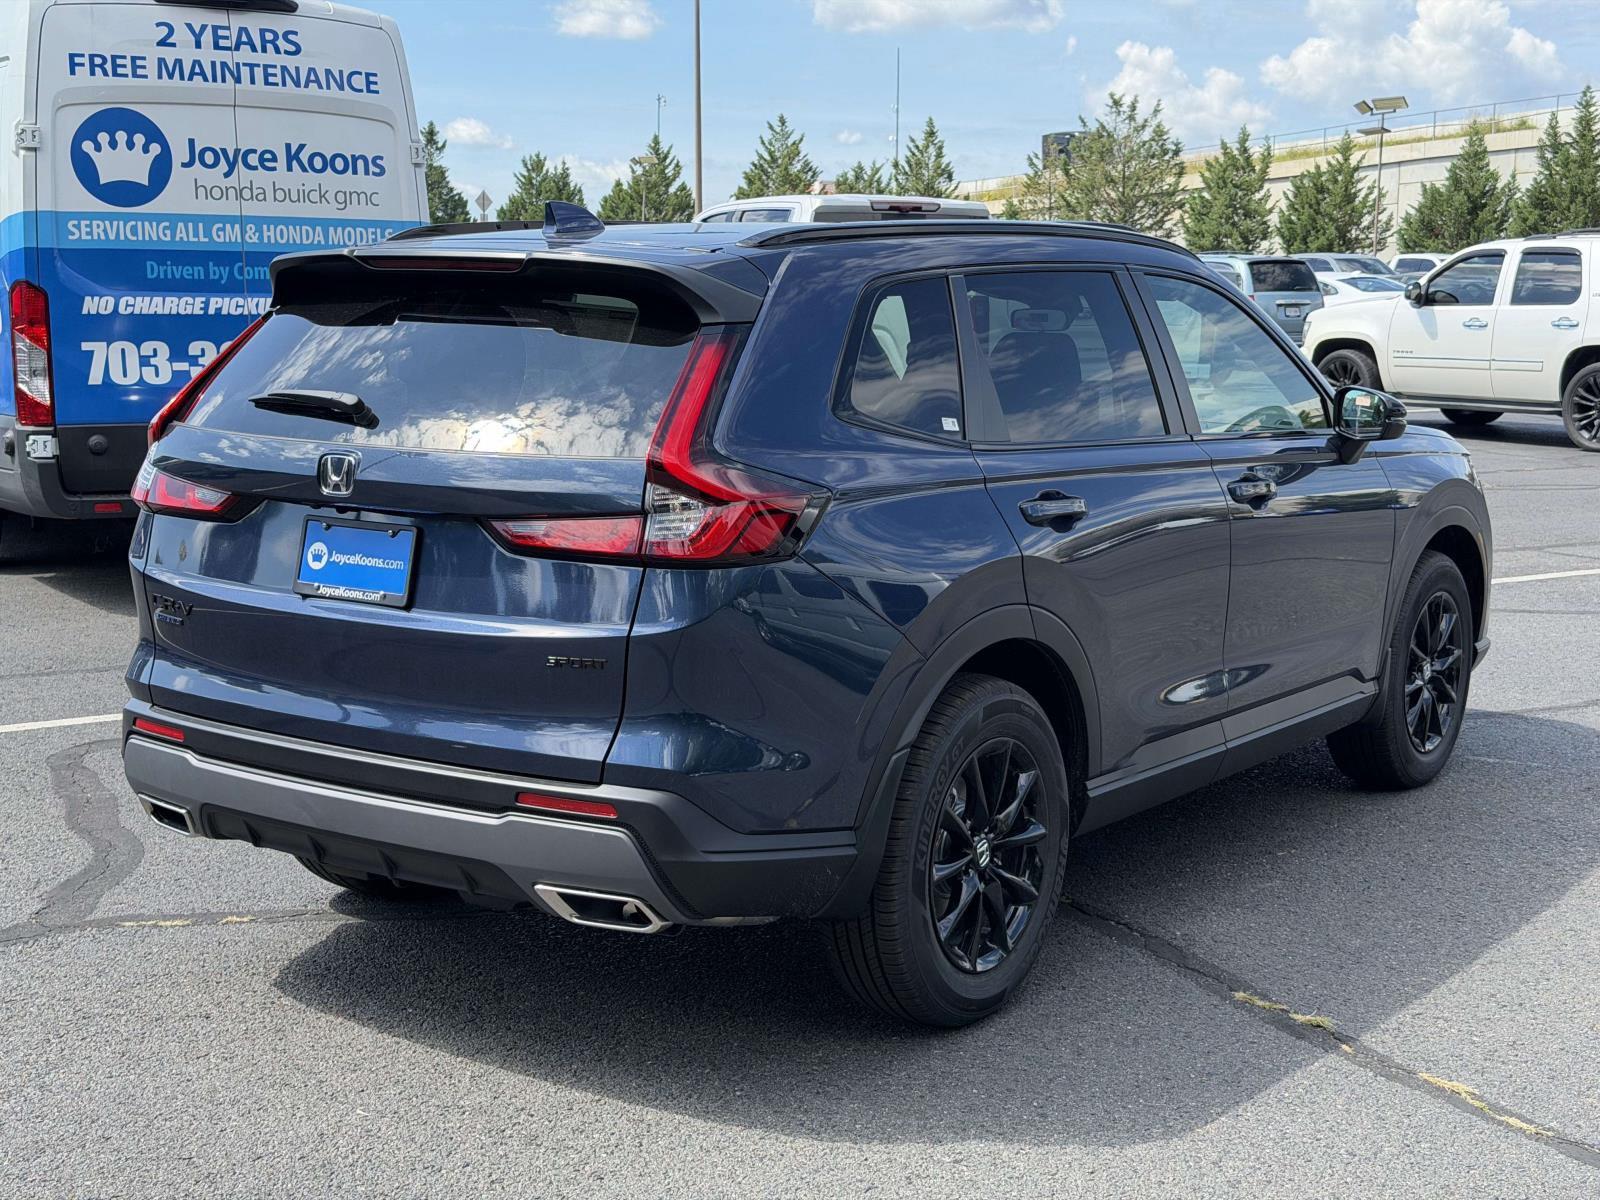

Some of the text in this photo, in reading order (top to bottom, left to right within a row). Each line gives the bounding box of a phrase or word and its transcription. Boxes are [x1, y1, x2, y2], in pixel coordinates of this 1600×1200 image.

[155, 21, 302, 57] 2 YEARS
[68, 52, 380, 95] FREE MAINTENANCE
[181, 137, 386, 180] Joyce Koons
[194, 178, 380, 211] honda buick gmc
[67, 220, 172, 241] SERVICING
[175, 222, 209, 242] ALL
[212, 223, 241, 243] GM
[245, 223, 260, 244] &
[263, 224, 325, 245] HONDA
[146, 261, 205, 280] Driven
[209, 262, 229, 284] by
[82, 296, 115, 315] NO
[118, 296, 205, 315] CHARGE
[81, 341, 234, 385] 703-3
[329, 550, 404, 570] JoyceKoons.com
[318, 584, 381, 601] JoyceKoons.com
[545, 655, 608, 670] SPORT
